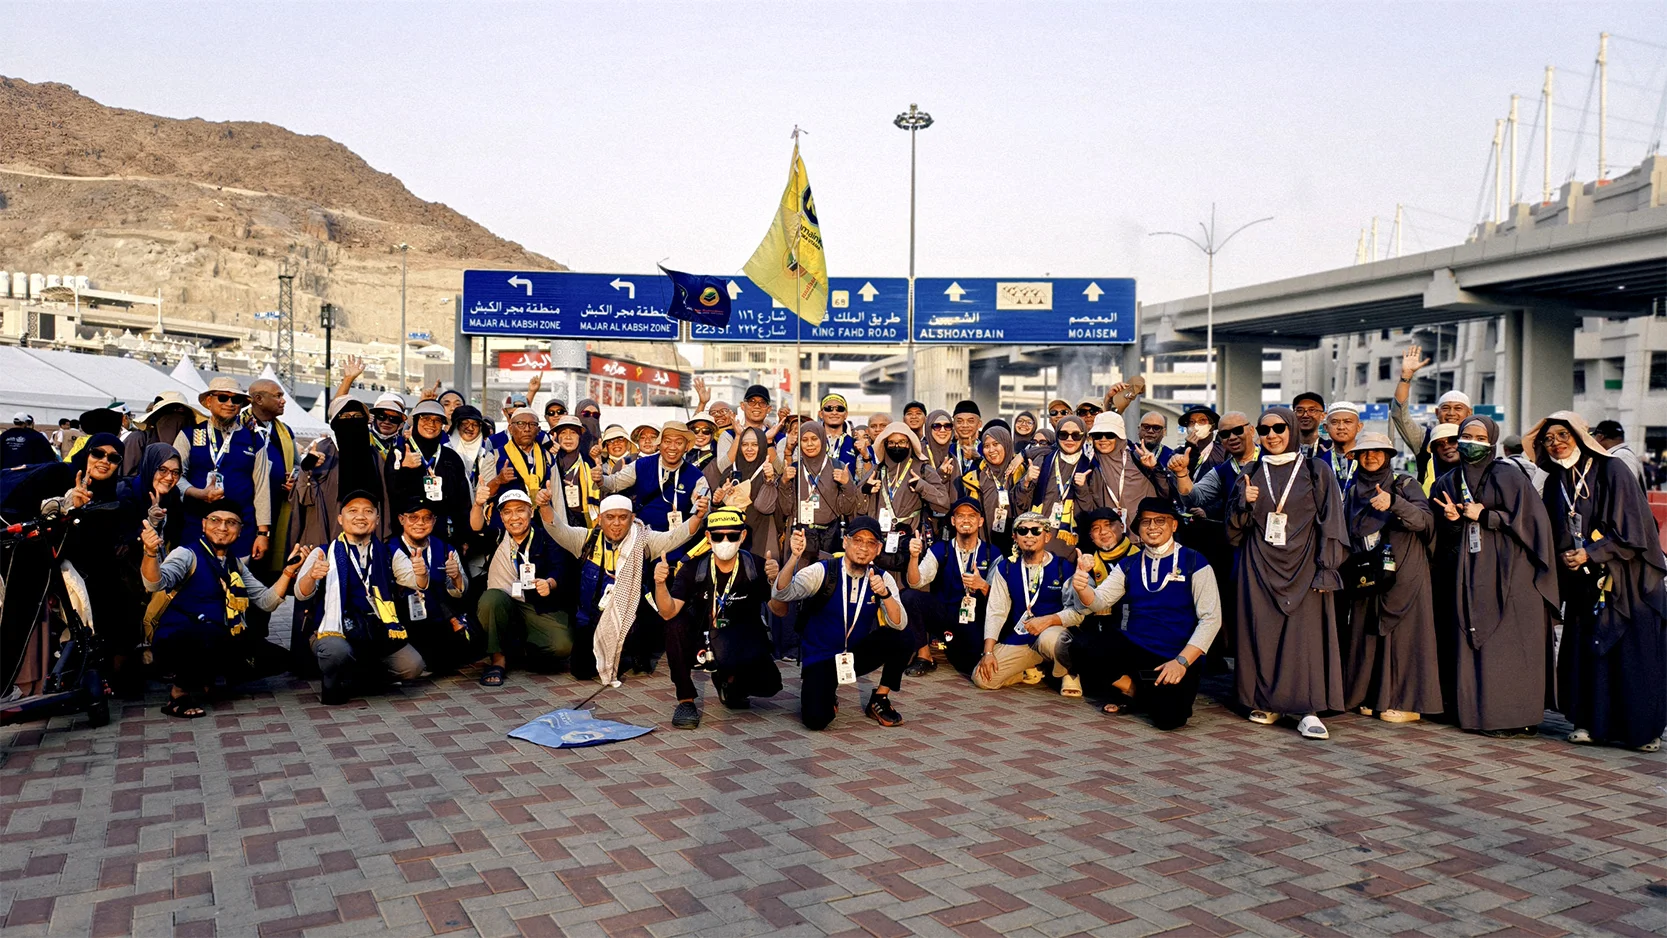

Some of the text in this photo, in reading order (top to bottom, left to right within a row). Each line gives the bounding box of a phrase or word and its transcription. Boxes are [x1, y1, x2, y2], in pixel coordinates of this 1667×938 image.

[470, 300, 560, 315] منطقة مجر الكبش
[580, 304, 668, 318] نطقة مجر الكبش
[469, 318, 561, 329] MAJAR AL KABSH ZONE
[757, 310, 786, 324] شارع
[833, 311, 864, 323] الملك
[869, 312, 901, 326] طريق
[1069, 312, 1117, 326] المعيصم
[580, 321, 671, 332] MAJAR AL KABSH ZONE
[695, 324, 716, 334] 223
[757, 324, 786, 338] شارع
[812, 327, 896, 337] KING FAHD ROAD
[1068, 328, 1117, 338] MOAISEM
